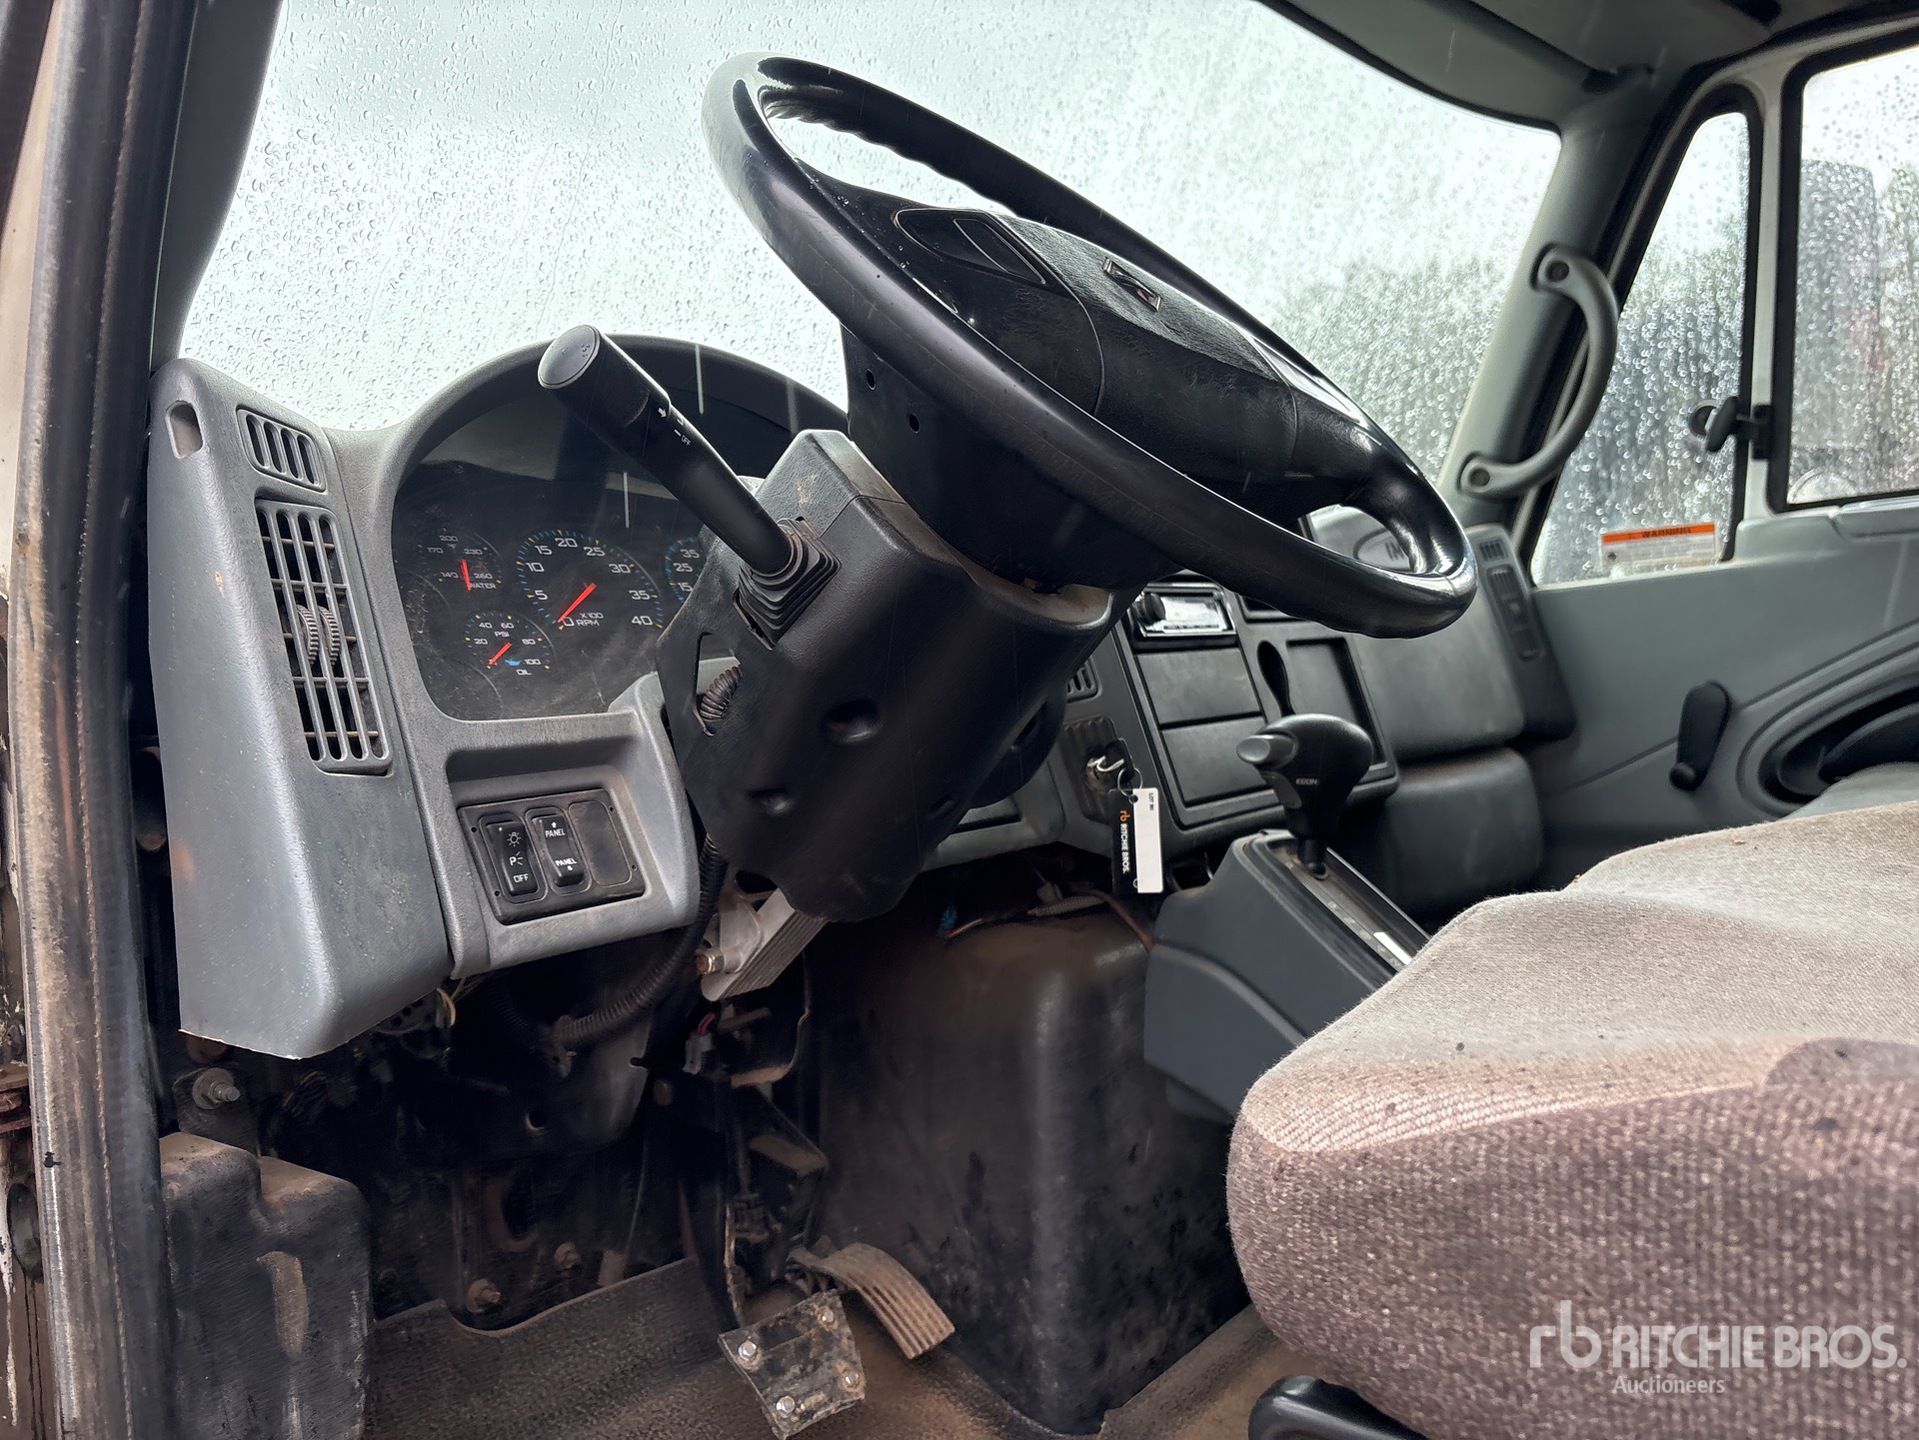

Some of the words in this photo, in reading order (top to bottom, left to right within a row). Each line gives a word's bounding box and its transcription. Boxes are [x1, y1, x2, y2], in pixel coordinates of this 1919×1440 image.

[681, 434, 692, 446] OFF
[554, 537, 578, 548] 20
[534, 545, 553, 555] 15
[583, 546, 606, 557] 25
[680, 549, 700, 559] 35
[526, 562, 545, 572] 10
[608, 563, 631, 574] 30
[673, 562, 693, 572] 25
[440, 571, 459, 579] 140
[677, 582, 693, 592] 15
[534, 590, 548, 600] 5
[628, 590, 650, 600] 35
[575, 619, 600, 627] RPM
[631, 615, 653, 625] 40
[545, 829, 566, 838] PANEL
[1120, 823, 1129, 851] RITCHIE
[555, 857, 577, 867] PANEL
[512, 873, 529, 883] OFF
